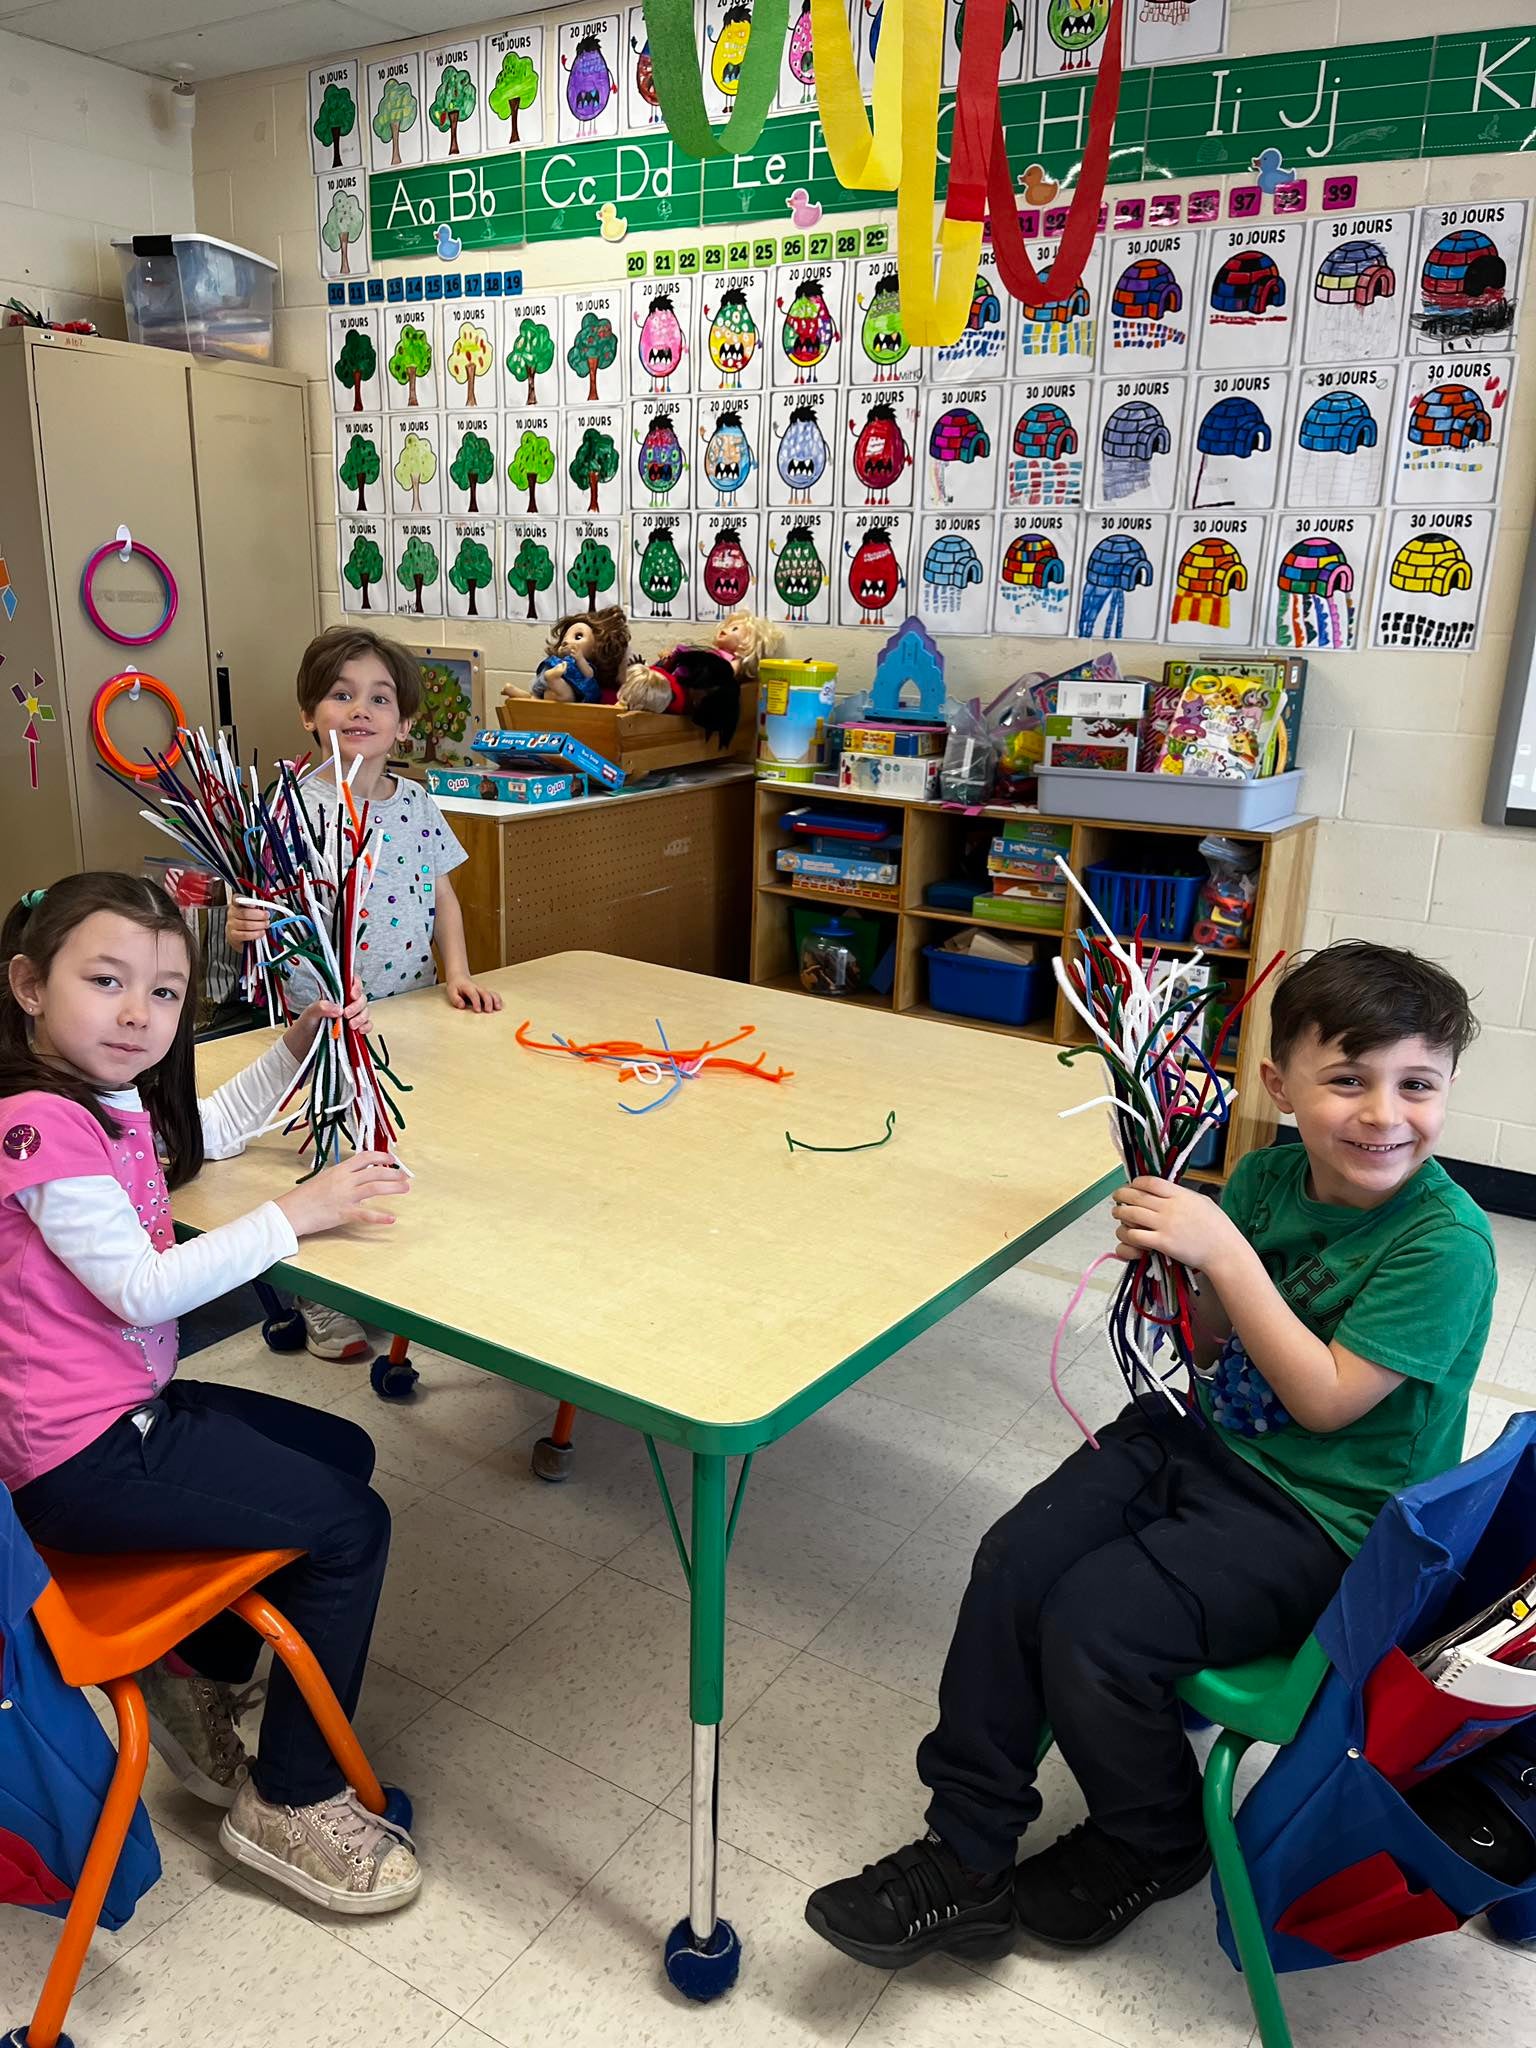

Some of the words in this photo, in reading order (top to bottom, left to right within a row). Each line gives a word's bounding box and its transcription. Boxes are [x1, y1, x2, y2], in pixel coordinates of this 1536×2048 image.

[570, 26, 581, 38] 20
[583, 21, 607, 35] JOURS
[498, 40, 505, 51] 10
[507, 37, 531, 50] JOURS
[436, 56, 444, 66] 10
[445, 51, 468, 65] JOURS
[319, 76, 326, 85] 10
[327, 69, 348, 82] JOURS
[378, 70, 385, 80] 10
[387, 64, 408, 78] JOURS
[1473, 36, 1536, 112] K
[1206, 70, 1242, 136] Ii
[1279, 60, 1341, 158] Jj
[541, 154, 596, 208] Cc
[616, 141, 673, 202] Dd
[328, 181, 335, 190] 10
[336, 177, 356, 189] JOURS
[387, 179, 435, 229] Aa
[449, 167, 496, 221] Bb
[1234, 194, 1256, 211] 37
[1328, 185, 1352, 202] 39
[1441, 211, 1457, 226] 30
[1460, 208, 1505, 224] JOURS
[1332, 223, 1347, 237] 30
[1350, 219, 1393, 234] JOURS
[1228, 233, 1243, 247] 30
[1246, 229, 1286, 245] JOURS
[628, 257, 644, 270] 20
[656, 256, 670, 269] 21
[680, 254, 695, 268] 22
[706, 250, 720, 264] 23
[730, 247, 747, 261] 24
[756, 244, 772, 258] 25
[784, 242, 800, 256] 26
[811, 240, 828, 254] 27
[838, 236, 855, 251] 28
[866, 231, 884, 246] 29
[1128, 242, 1141, 255] 30
[1144, 237, 1180, 254] JOURS
[1037, 247, 1050, 260] 30
[790, 269, 800, 280] 20
[802, 267, 832, 279] JOURS
[869, 264, 880, 275] 20
[882, 262, 898, 274] JOU
[331, 289, 344, 300] 10
[351, 288, 362, 299] 11
[369, 284, 381, 295] 12
[390, 283, 401, 294] 13
[409, 282, 421, 293] 14
[428, 280, 440, 292] 15
[446, 279, 459, 290] 16
[467, 279, 478, 290] 17
[487, 278, 499, 290] 18
[507, 277, 520, 288] 19
[715, 278, 726, 288] 20
[728, 276, 754, 288] JOURS
[643, 286, 653, 296] 20
[655, 283, 680, 294] JOURS
[514, 307, 522, 316] 10
[524, 305, 546, 316] JOURS
[576, 301, 584, 311] 10
[586, 299, 610, 310] JOURS
[395, 314, 402, 323] 10
[403, 312, 425, 323] JOURS
[453, 312, 461, 321] 10
[463, 309, 484, 320] JOURS
[340, 319, 347, 328] 10
[348, 318, 368, 327] JOURS
[1427, 365, 1443, 379] 30
[1446, 363, 1491, 378] JOURS
[1214, 379, 1228, 393] 30
[1231, 377, 1270, 391] JOURS
[1318, 372, 1333, 387] 30
[1336, 370, 1377, 386] JOURS
[1026, 386, 1038, 398] 30
[1041, 384, 1076, 398] JOURS
[1117, 384, 1130, 397] 30
[1132, 382, 1169, 395] JOURS
[784, 396, 794, 406] 20
[797, 394, 824, 406] JOURS
[861, 393, 872, 404] 20
[874, 392, 904, 403] JOURS
[942, 392, 953, 404] 30
[955, 391, 986, 402] JOURS
[644, 404, 654, 414] 20
[656, 403, 680, 414] JOURS
[710, 401, 721, 412] 20
[723, 400, 749, 410] JOURS
[400, 422, 407, 431] 10
[408, 421, 428, 430] JOURS
[457, 420, 464, 430] 10
[466, 420, 488, 430] JOURS
[516, 420, 523, 429] 10
[524, 419, 548, 428] JOURS
[578, 417, 585, 426] 10
[587, 416, 612, 426] JOURS
[345, 424, 352, 433] 10
[354, 423, 373, 433] JOURS
[643, 516, 653, 526] 20
[655, 516, 680, 527] JOURS
[710, 518, 720, 528] 20
[722, 517, 747, 528] JOURS
[781, 515, 792, 526] 20
[794, 516, 821, 526] JOURS
[856, 516, 868, 526] 20
[870, 516, 899, 527] JOURS
[935, 520, 947, 530] 30
[949, 519, 980, 531] JOURS
[1014, 518, 1026, 529] 30
[1029, 518, 1062, 529] JOURS
[1102, 518, 1114, 529] 30
[1116, 518, 1152, 529] JOURS
[1193, 520, 1207, 533] 30
[1209, 520, 1248, 533] JOURS
[1296, 519, 1310, 532] 30
[1313, 519, 1354, 532] JOURS
[1410, 514, 1425, 527] 30
[1429, 514, 1473, 527] JOURS
[349, 524, 356, 534] 10
[357, 525, 376, 534] JOURS
[402, 526, 410, 534] 10
[411, 526, 431, 534] JOURS
[456, 527, 463, 536] 10
[464, 527, 486, 536] JOURS
[515, 528, 522, 537] 10
[524, 528, 547, 538] JOURS
[576, 527, 582, 536] 10
[585, 527, 608, 537] JOURS
